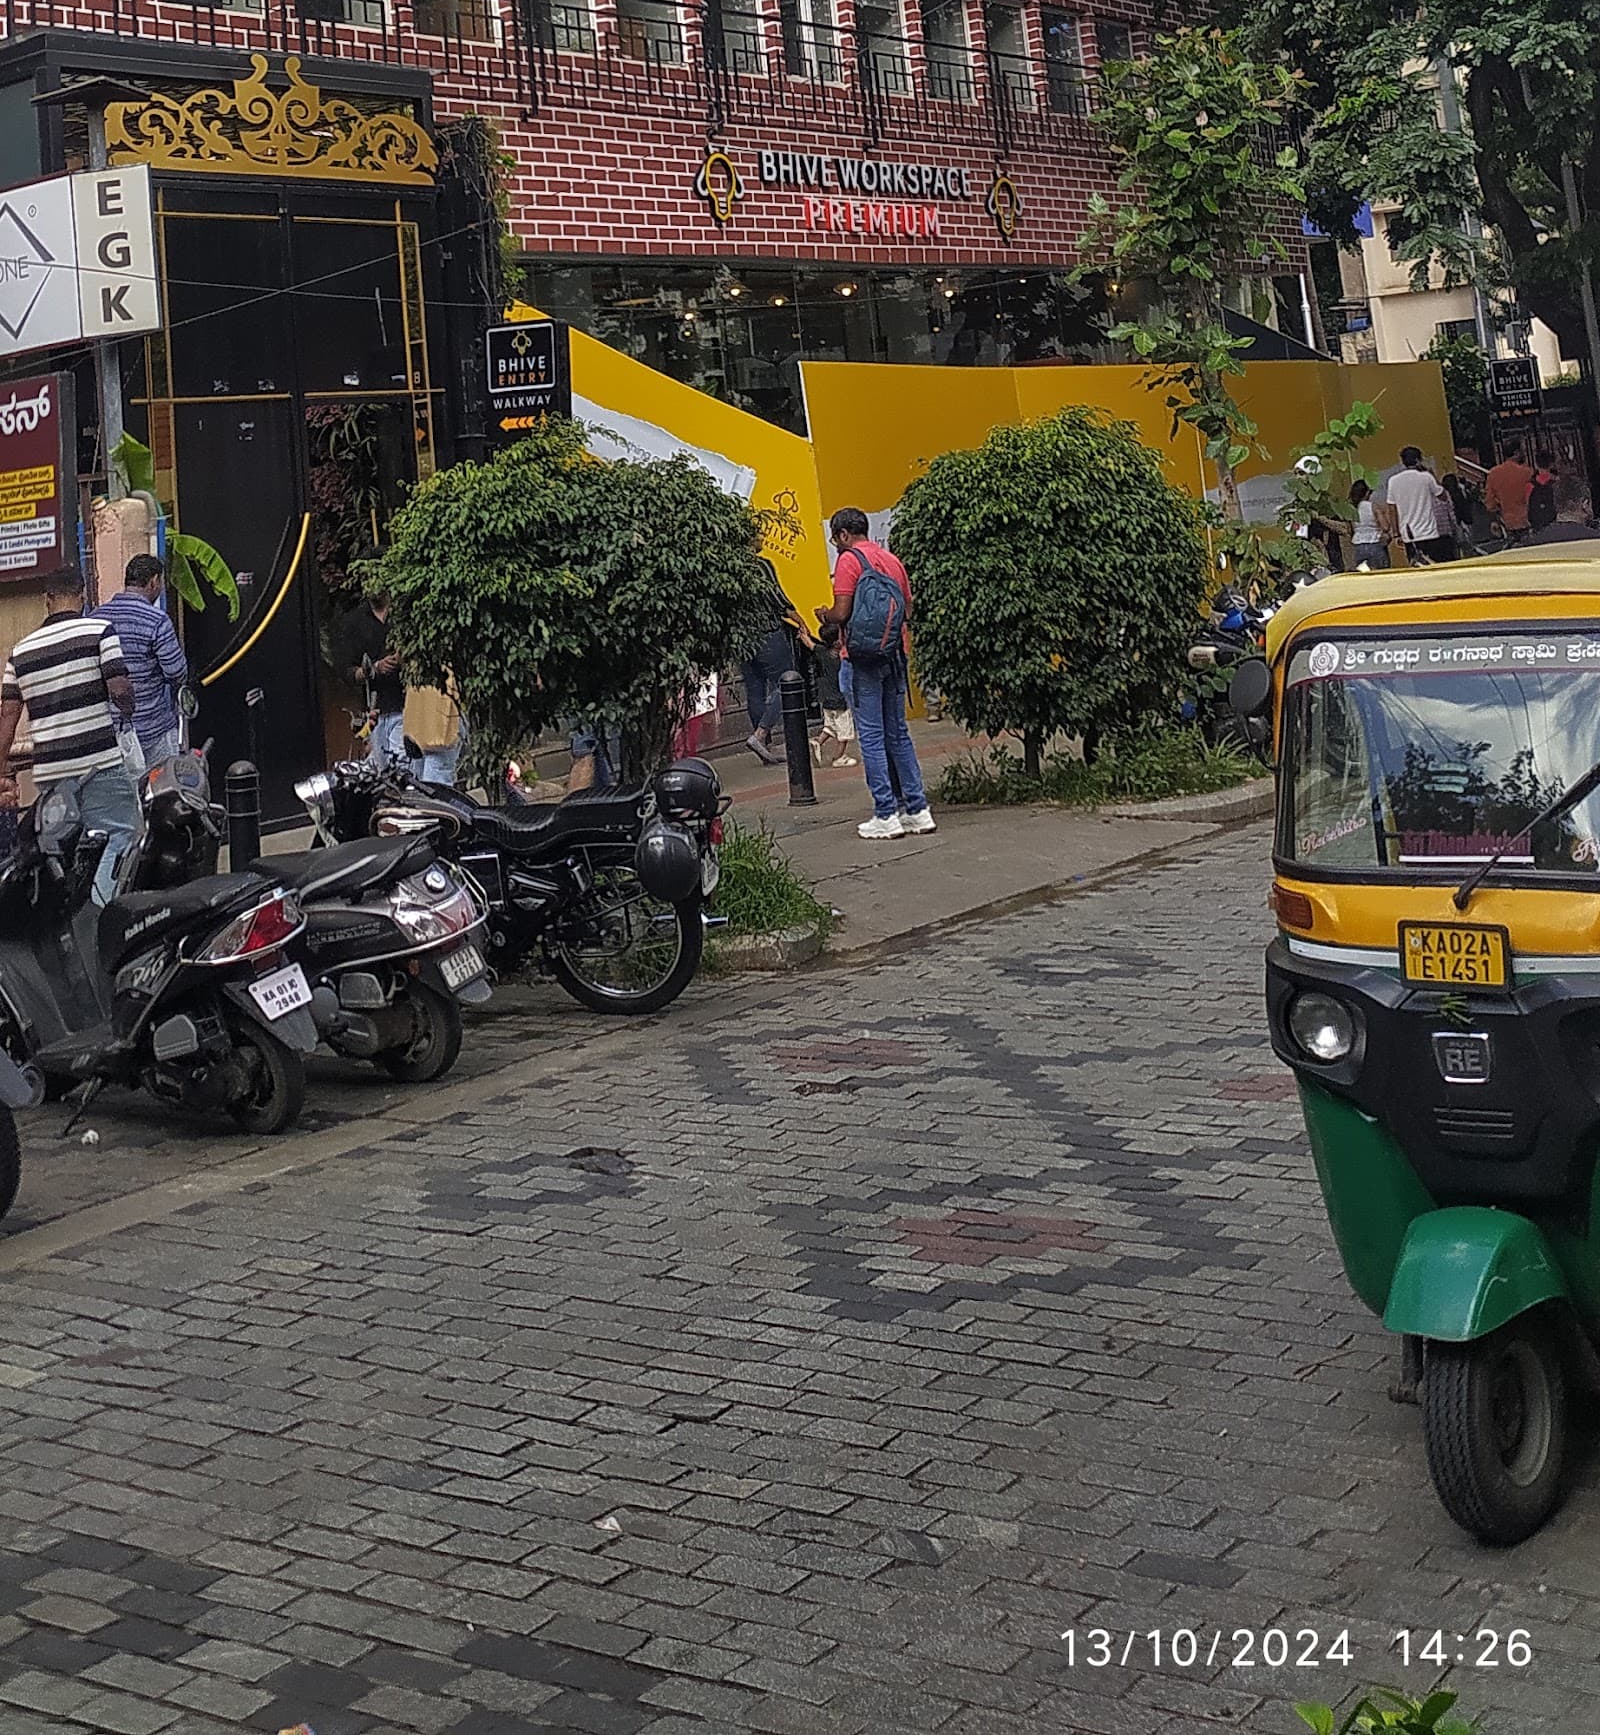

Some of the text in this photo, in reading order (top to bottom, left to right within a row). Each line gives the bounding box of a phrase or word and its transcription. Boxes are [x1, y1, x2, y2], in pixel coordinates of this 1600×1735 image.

[760, 150, 974, 198] BHIVE WORKSPACE
[804, 198, 939, 238] PREMIUM
[0, 255, 30, 283] NE
[498, 355, 546, 374] BHIVE
[498, 371, 547, 386] ENTRY
[493, 394, 552, 410] WALKWAY
[1343, 648, 1366, 670] ಶ್ರೀ
[1511, 643, 1557, 665] ಸ್ವಾಮಿ
[1421, 930, 1492, 957] KA02A
[1422, 956, 1490, 982] E1451
[1444, 1048, 1483, 1072] RE
